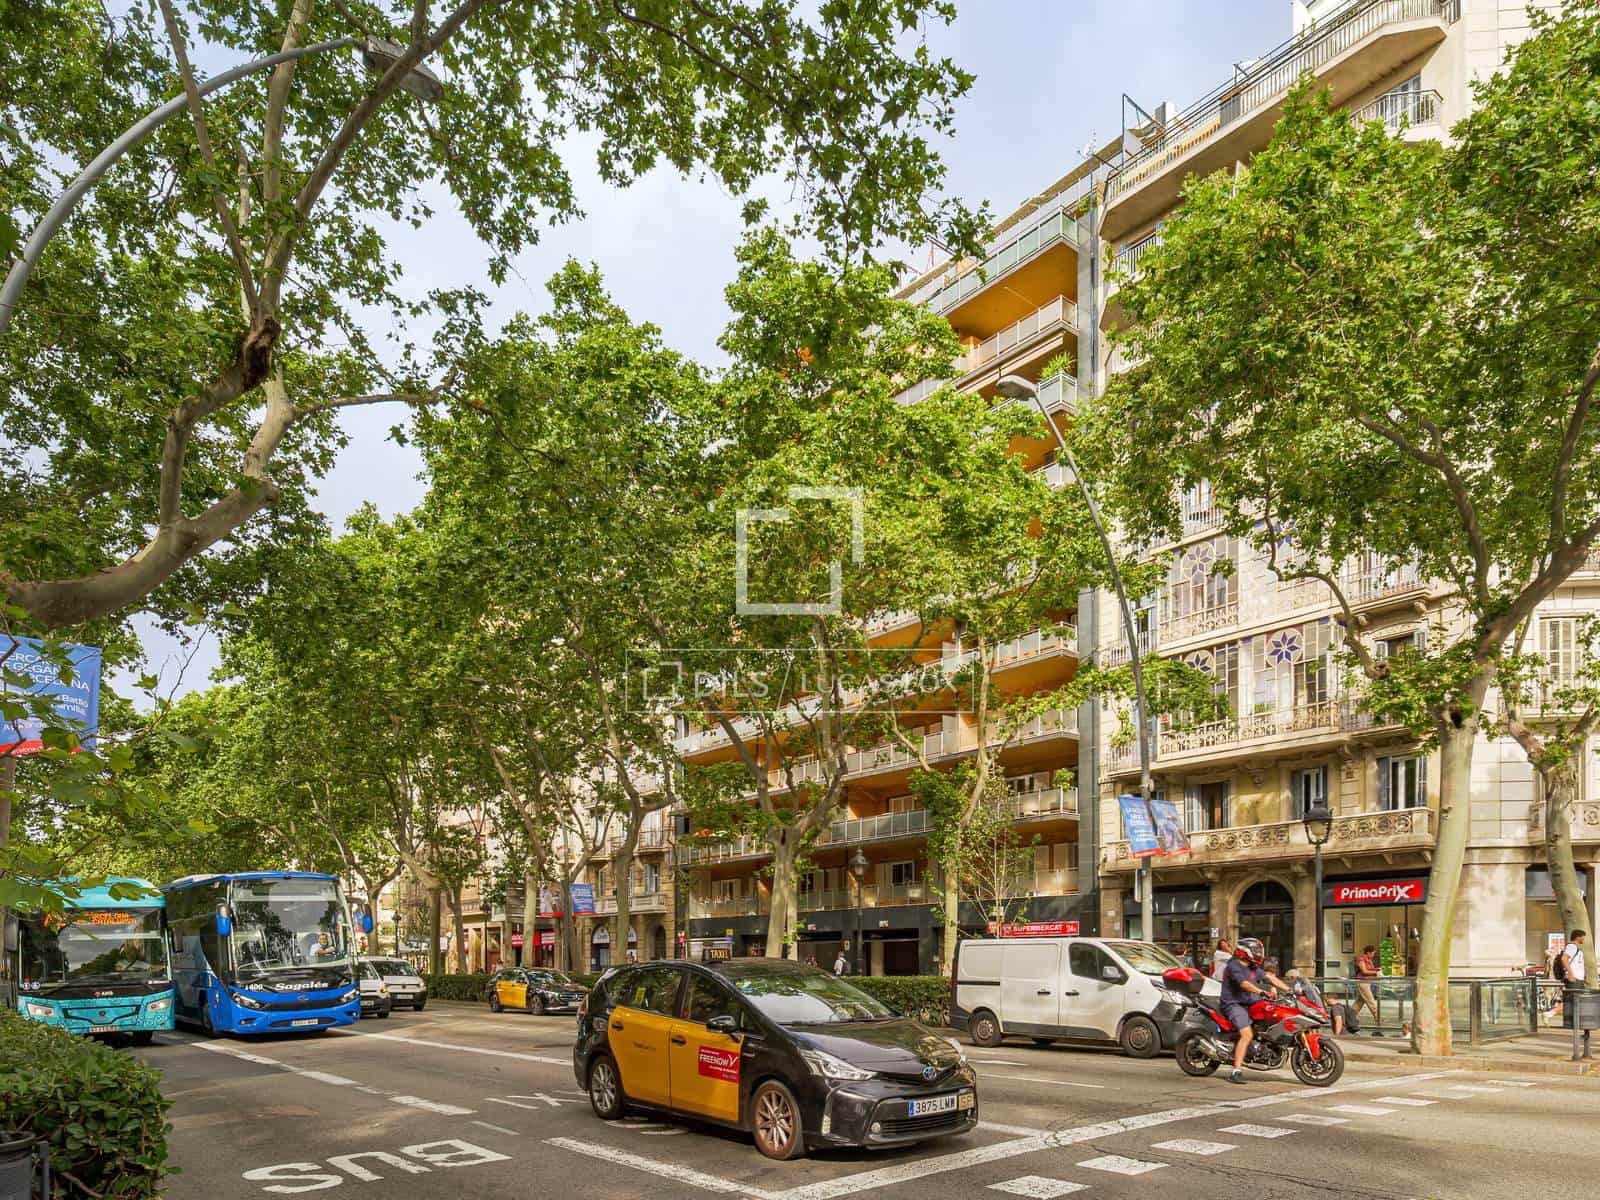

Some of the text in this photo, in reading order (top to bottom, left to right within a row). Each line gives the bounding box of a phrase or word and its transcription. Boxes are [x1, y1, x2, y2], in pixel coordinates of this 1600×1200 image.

[13, 662, 81, 679] GEGANS
[710, 949, 725, 959] TAXI
[274, 981, 329, 991] Sagalés
[699, 1054, 729, 1067] FREENOW
[915, 1100, 938, 1113] 3875
[242, 1139, 513, 1194] BUS
